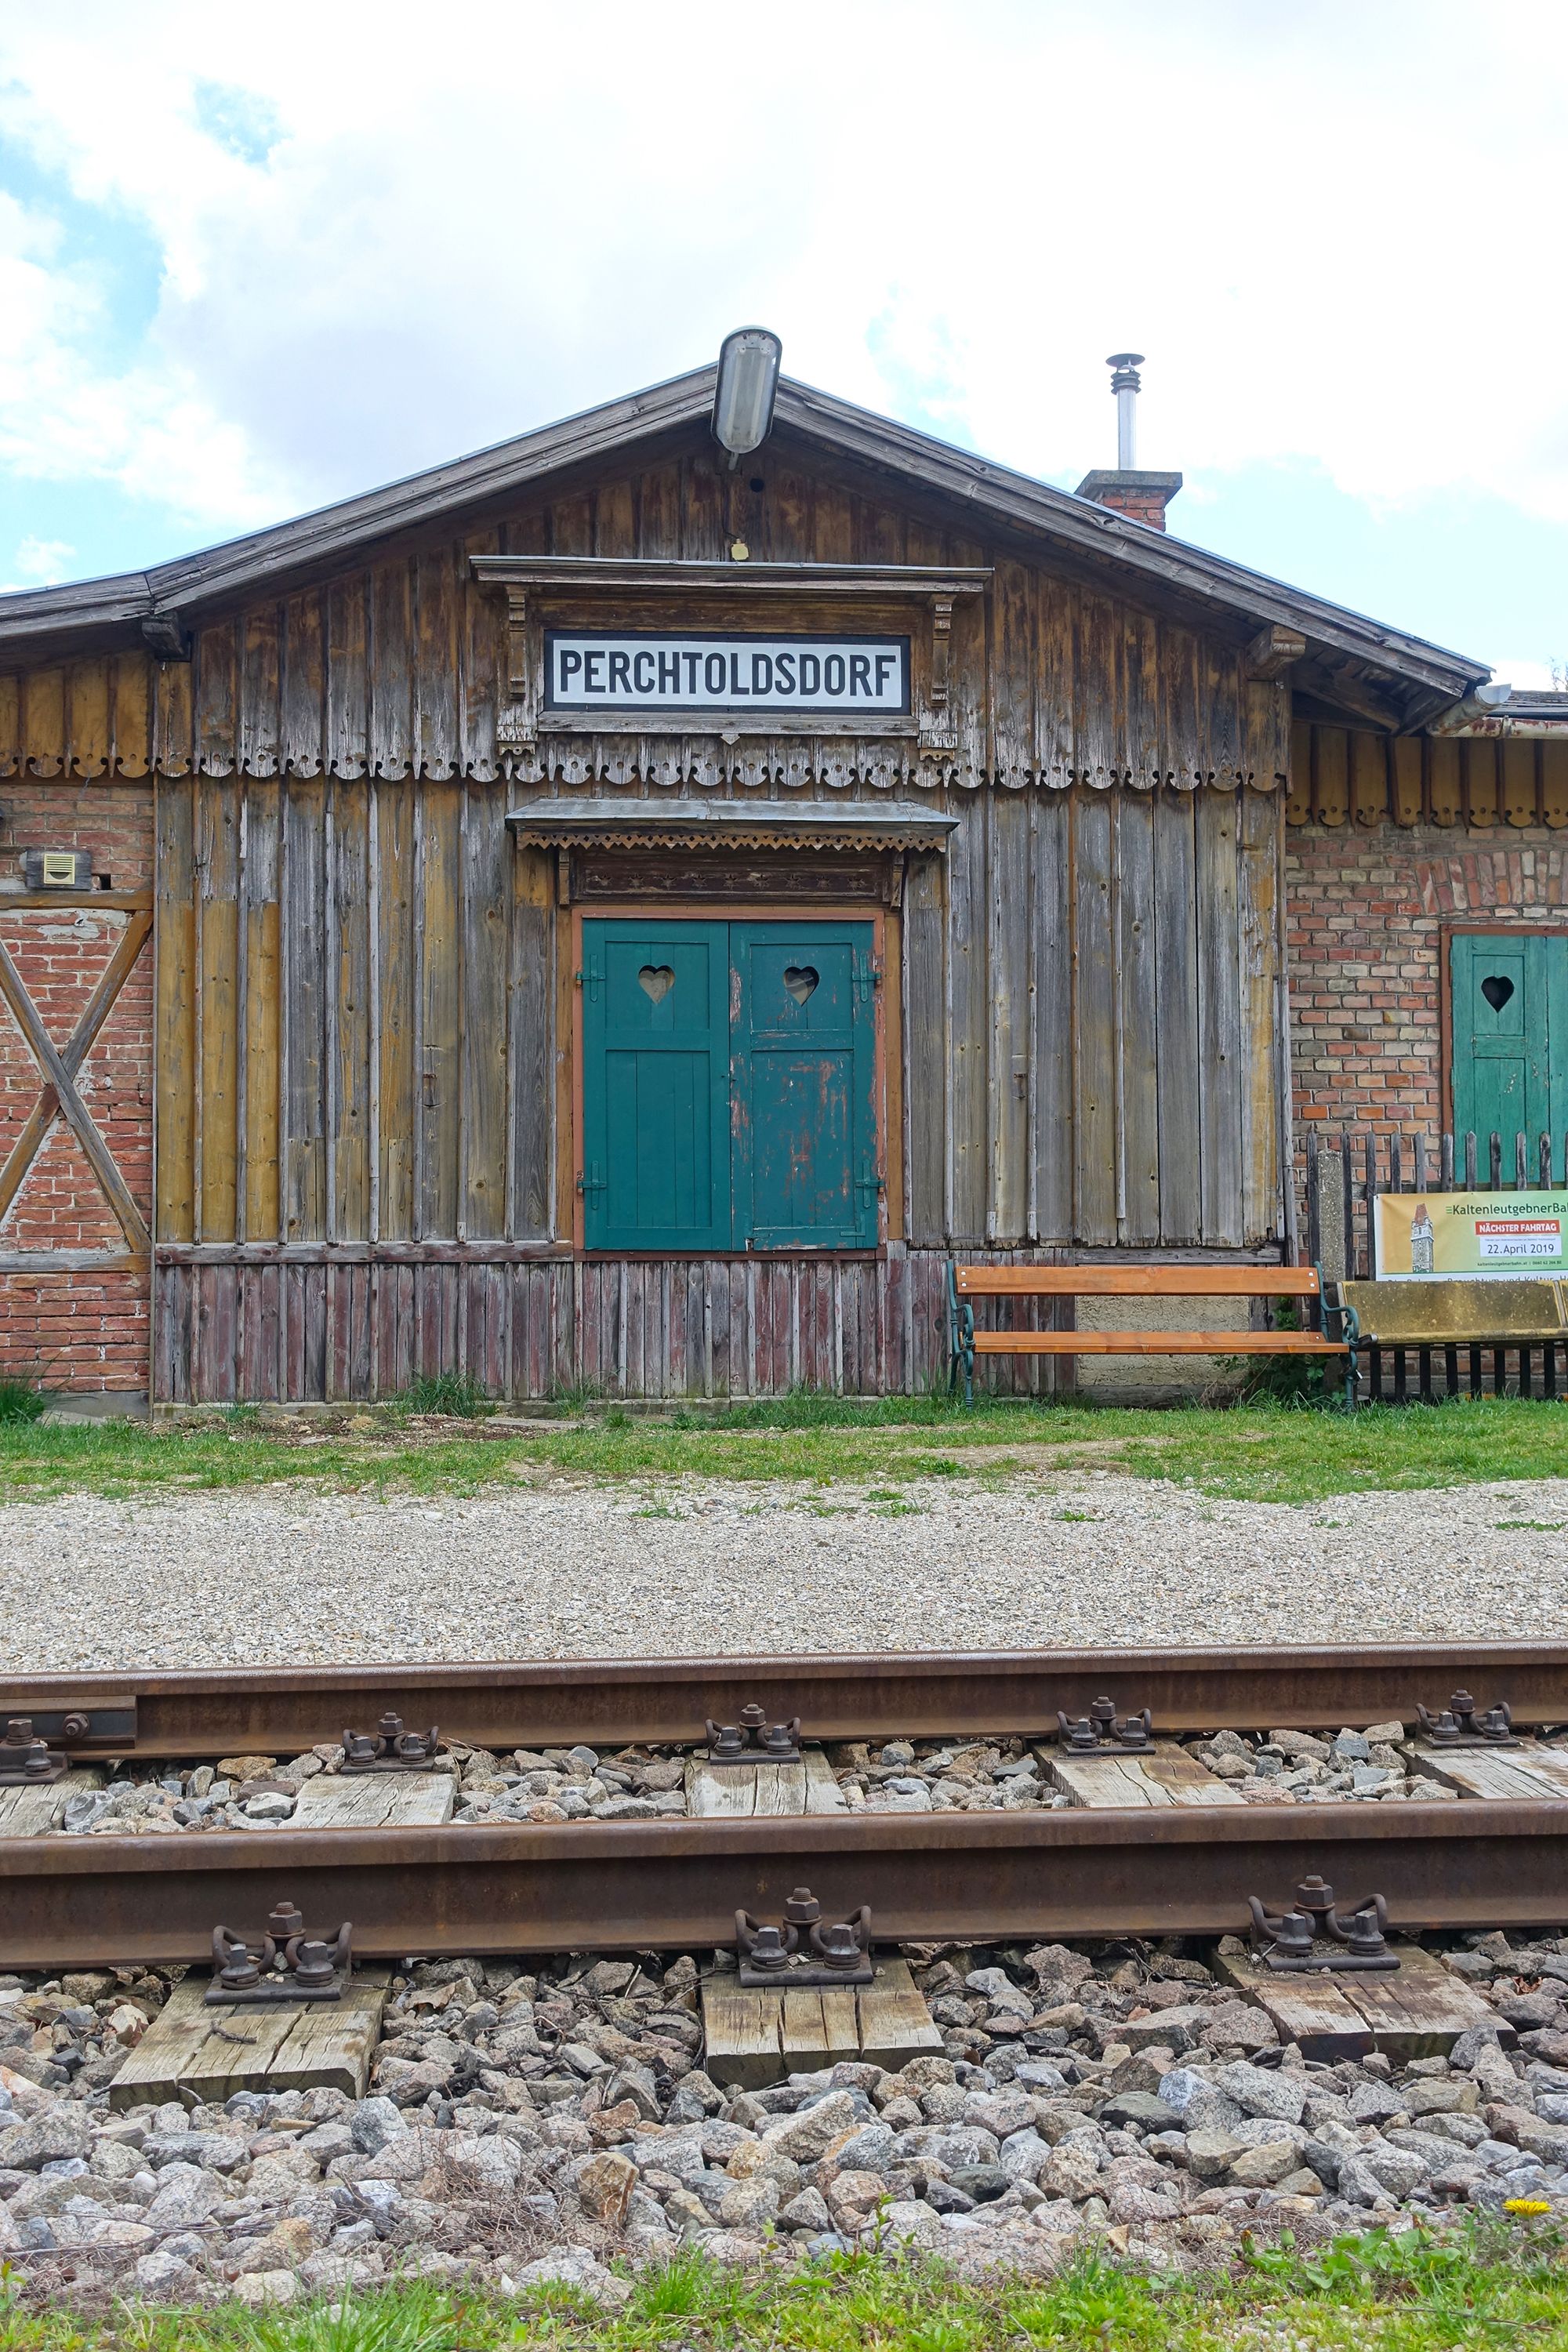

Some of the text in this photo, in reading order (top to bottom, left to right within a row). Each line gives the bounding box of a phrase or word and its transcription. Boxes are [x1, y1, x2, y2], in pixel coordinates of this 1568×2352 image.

[560, 649, 897, 697] PERCHTOLDSDORF
[1453, 1202, 1568, 1216] KaltenleutgebnerBa
[1479, 1222, 1557, 1233] NÄCHSTER FAHRTAG
[1530, 1243, 1555, 1254] 2019
